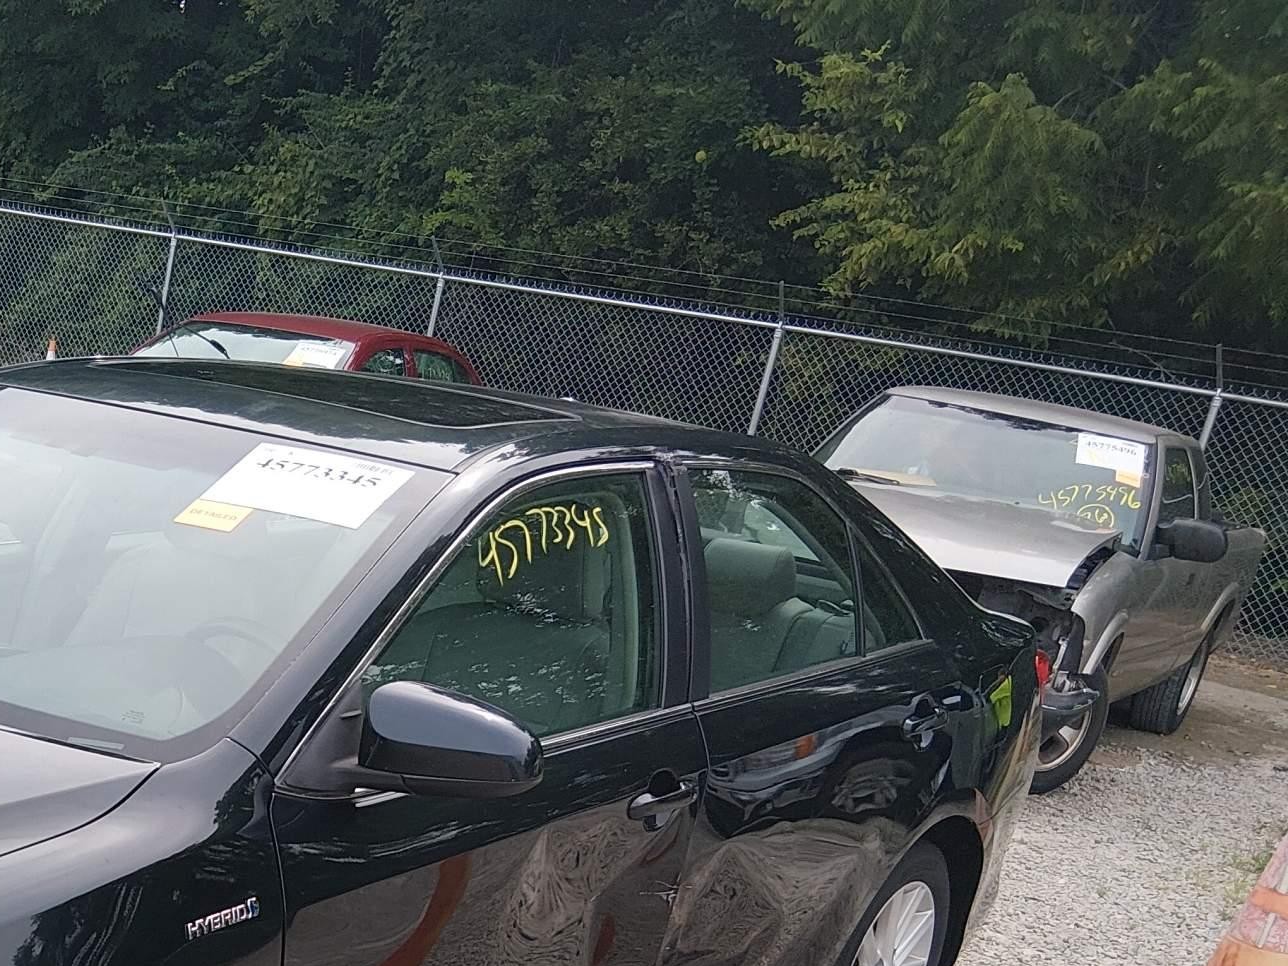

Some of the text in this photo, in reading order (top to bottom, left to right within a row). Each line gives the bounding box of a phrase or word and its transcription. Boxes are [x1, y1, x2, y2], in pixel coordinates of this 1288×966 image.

[257, 457, 382, 487] 45773345
[478, 504, 609, 587] 45773345
[185, 903, 247, 941] HYBRID
